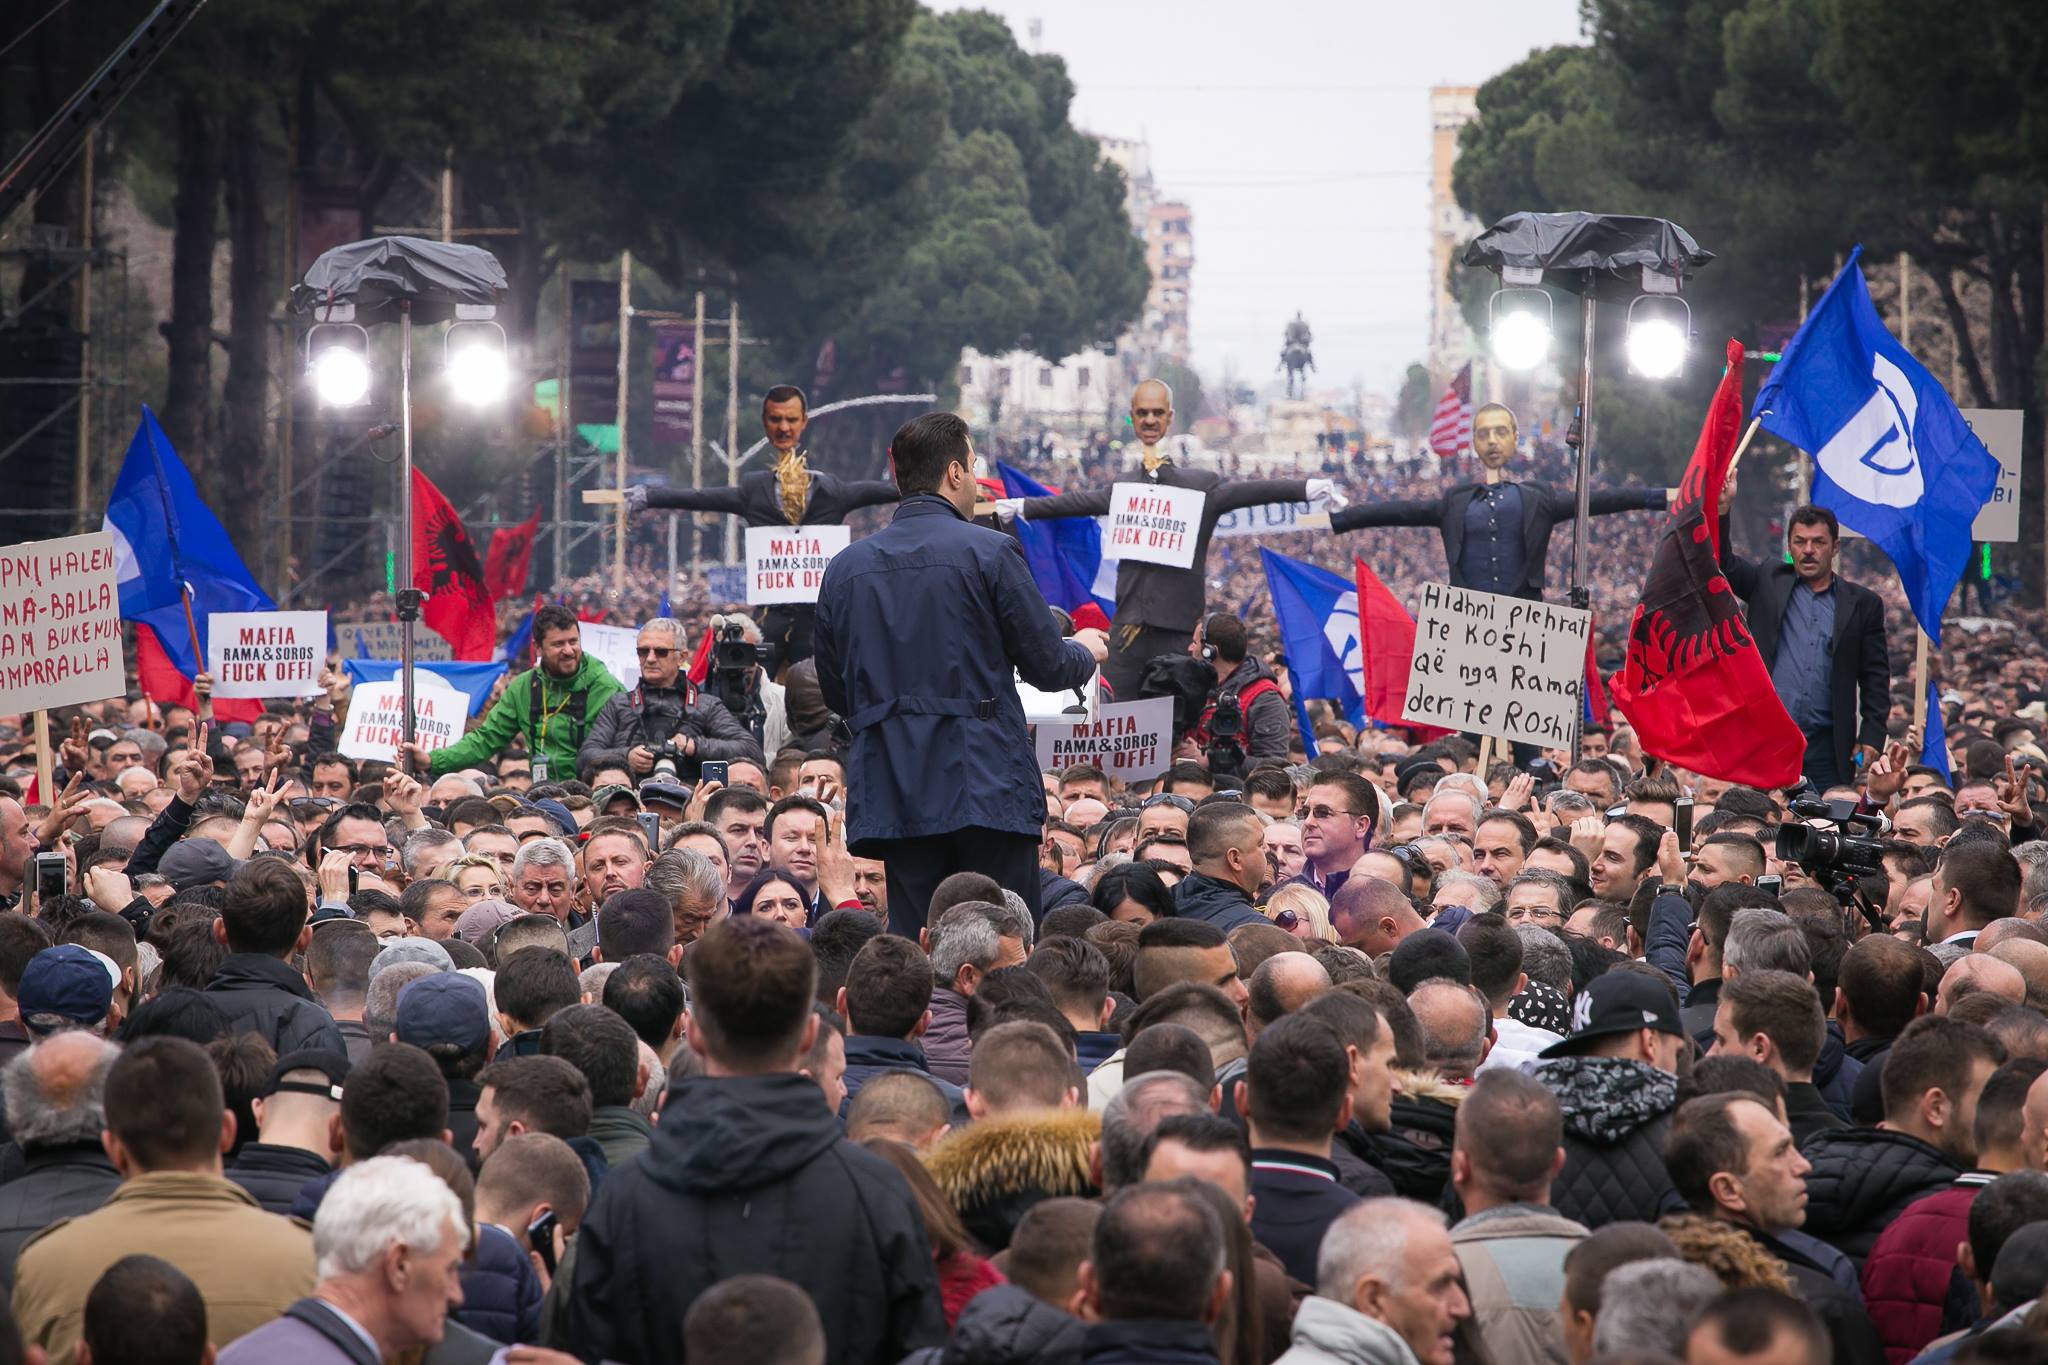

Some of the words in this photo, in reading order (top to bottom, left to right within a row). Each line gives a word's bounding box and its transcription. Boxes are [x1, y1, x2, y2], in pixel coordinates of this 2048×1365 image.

[1127, 496, 1172, 517] MAFIA
[770, 539, 821, 556] MAFIA
[1112, 527, 1142, 545] FUCK
[1148, 530, 1183, 552] OFF!
[50, 546, 113, 581] HALEN
[757, 571, 795, 590] FUCK
[1425, 584, 1495, 620] Hidhni
[239, 627, 295, 645] MAFIA
[1427, 617, 1450, 641] te
[223, 646, 314, 661] RAMA&SOROS
[222, 663, 267, 682] FUCK
[275, 661, 312, 680] OFF!
[1459, 664, 1497, 686] nga
[1511, 665, 1579, 700] Rama
[378, 695, 434, 717] MAIA
[1407, 683, 1455, 719] deri
[1464, 699, 1493, 725] te
[1503, 700, 1573, 743] Roshi
[354, 725, 401, 747] FUCK
[1072, 716, 1137, 739] MAFIA
[1053, 732, 1158, 754] RAMA&SOROS
[1113, 747, 1155, 770] OFF!
